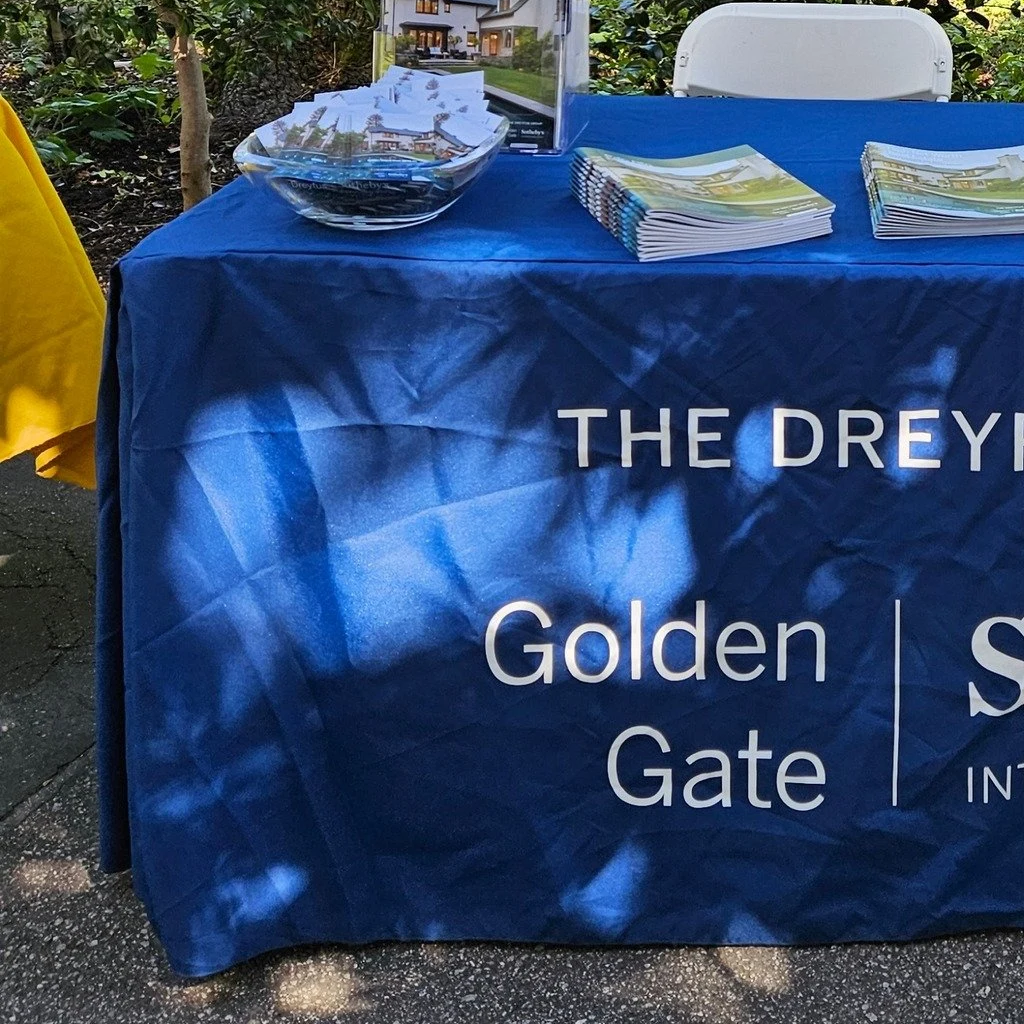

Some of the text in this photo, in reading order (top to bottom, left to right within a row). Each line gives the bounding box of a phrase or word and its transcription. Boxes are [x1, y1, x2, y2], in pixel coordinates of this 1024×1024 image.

[557, 407, 731, 469] THE
[484, 599, 826, 686] Golden
[607, 725, 826, 812] Gate
